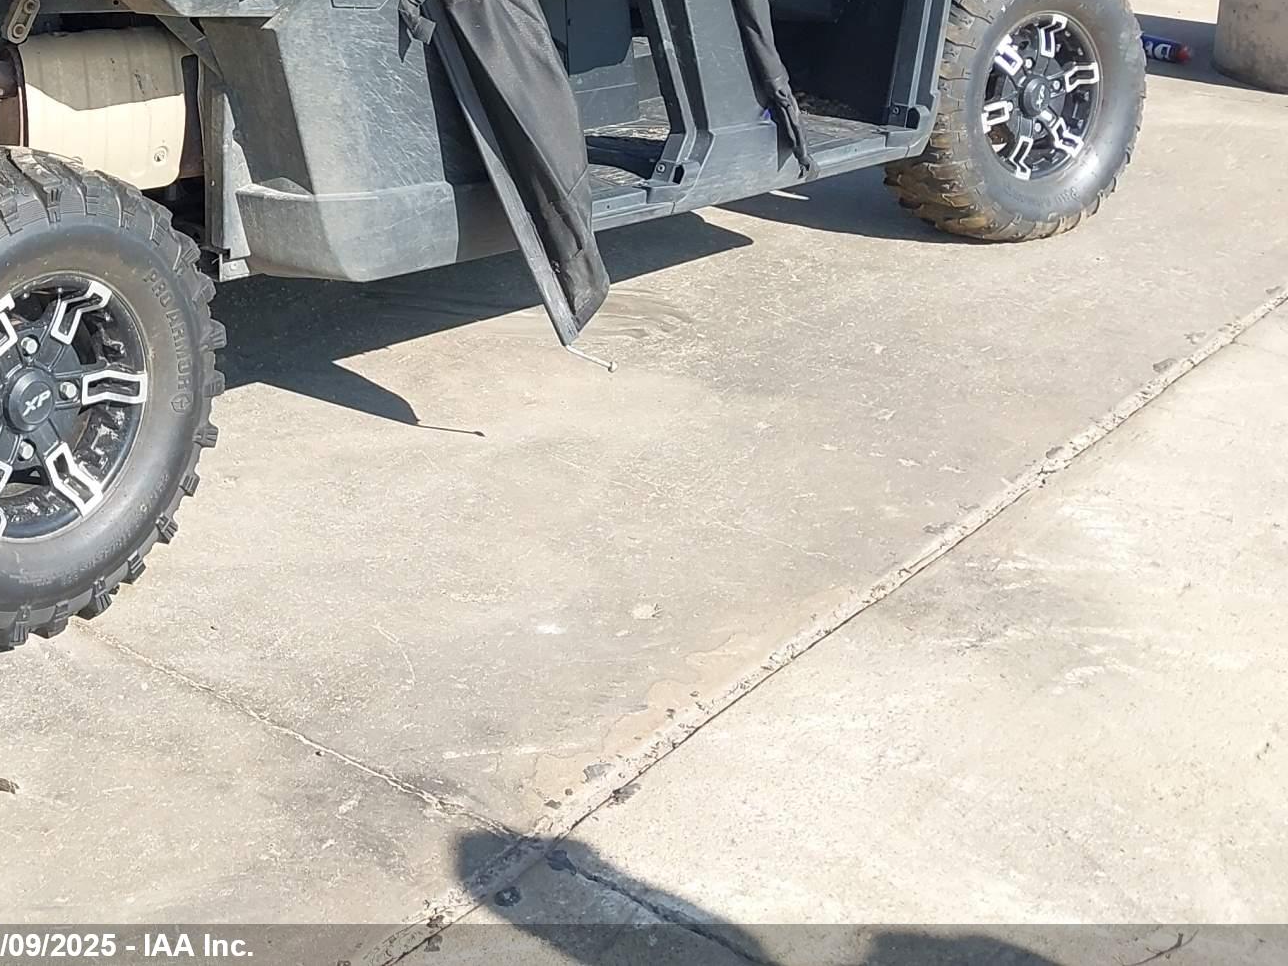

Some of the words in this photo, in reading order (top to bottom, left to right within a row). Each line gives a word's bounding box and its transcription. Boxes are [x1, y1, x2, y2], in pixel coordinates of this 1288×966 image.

[143, 268, 175, 308] PRO
[166, 308, 193, 391] ARMOR
[22, 389, 51, 416] XP
